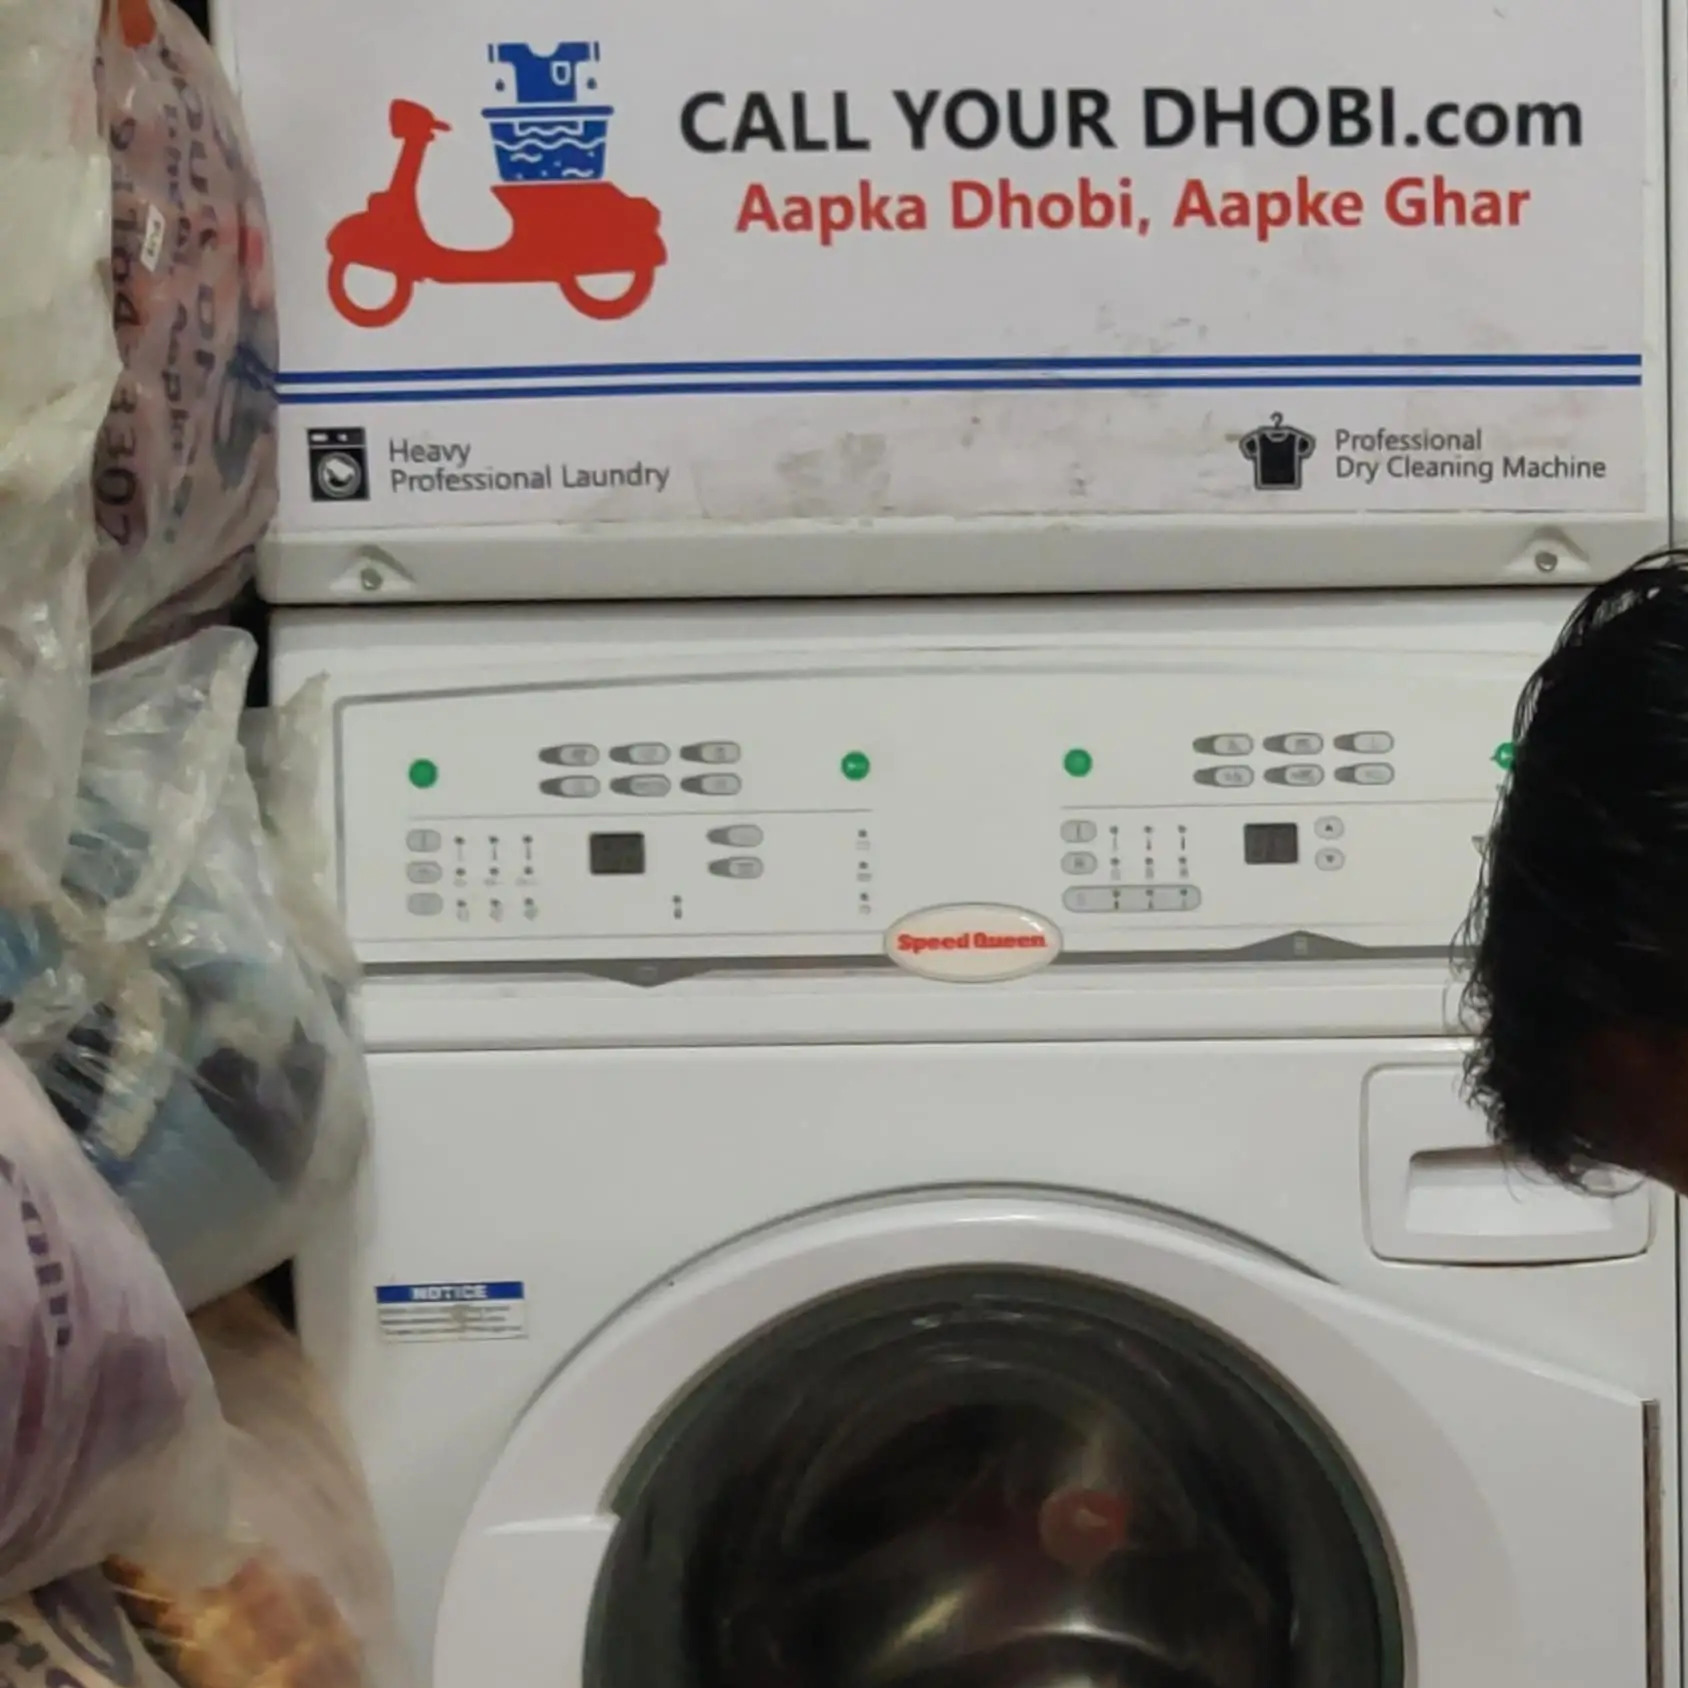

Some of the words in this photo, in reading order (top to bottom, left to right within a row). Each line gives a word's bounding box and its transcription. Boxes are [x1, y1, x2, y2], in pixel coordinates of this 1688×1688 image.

[680, 90, 870, 154] CALL
[893, 88, 1117, 150] YOUR
[1143, 85, 1582, 149] DHOBI.com
[736, 181, 928, 246] Aapka
[950, 177, 1149, 236] Dhobi,
[1172, 175, 1364, 242] Aapke
[1384, 175, 1531, 228] Ghar
[389, 438, 471, 466] Heavy
[1335, 428, 1482, 452] Professional
[390, 464, 552, 493] Professional
[562, 461, 670, 491] Laundry
[1336, 457, 1380, 485] Dry
[1386, 454, 1494, 484] Cleaning
[1502, 455, 1607, 479] Machine
[898, 933, 970, 953] Speed
[974, 932, 1046, 948] Queen
